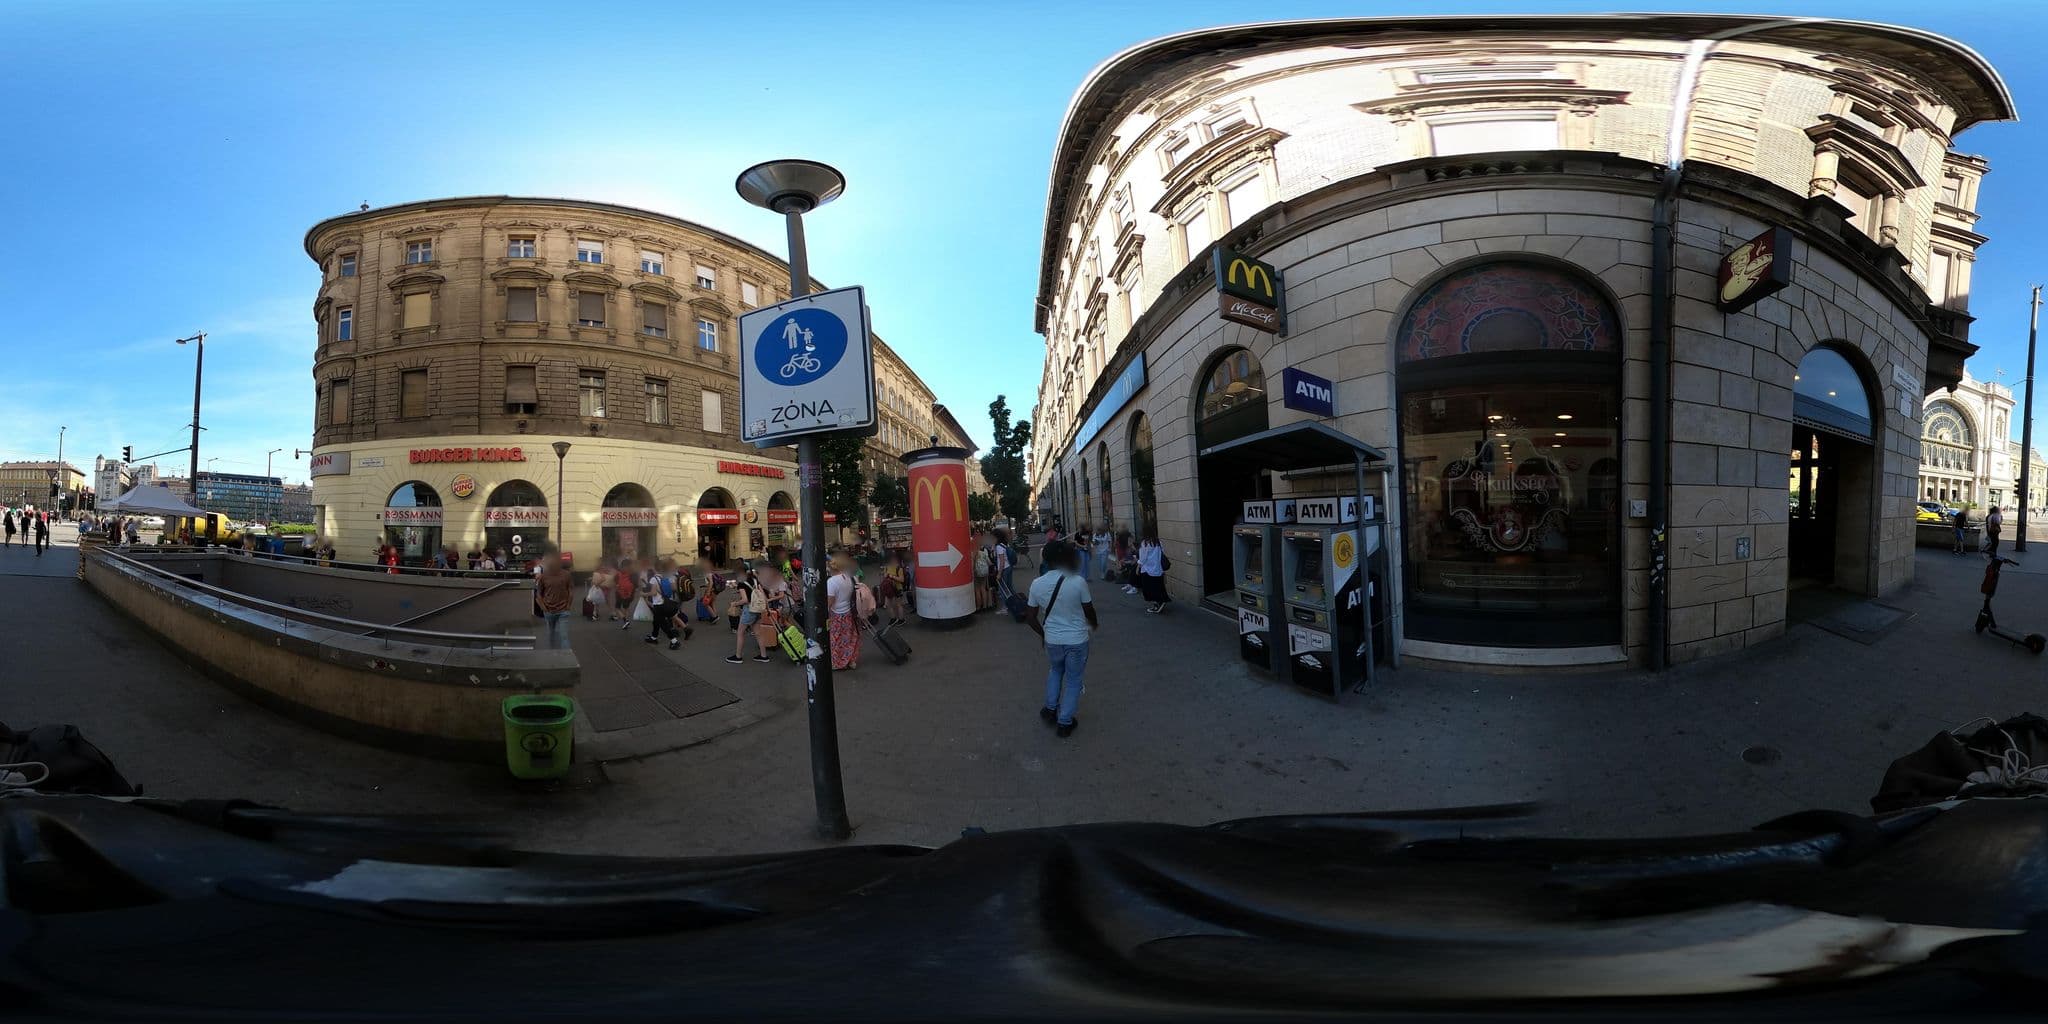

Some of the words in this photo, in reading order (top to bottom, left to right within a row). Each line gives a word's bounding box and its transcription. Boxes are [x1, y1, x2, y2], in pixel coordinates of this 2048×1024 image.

[1295, 379, 1331, 403] ATM
[771, 399, 835, 423] ZÓNA
[409, 448, 473, 464] BURGER
[718, 461, 760, 475] BURGER
[385, 510, 442, 519] ROSSMANN
[486, 511, 548, 520] ROSSMANN
[603, 511, 658, 520] ROSSMANN
[1247, 506, 1271, 519] ATM
[1301, 503, 1333, 518] ATM
[1243, 611, 1264, 627] ATM
